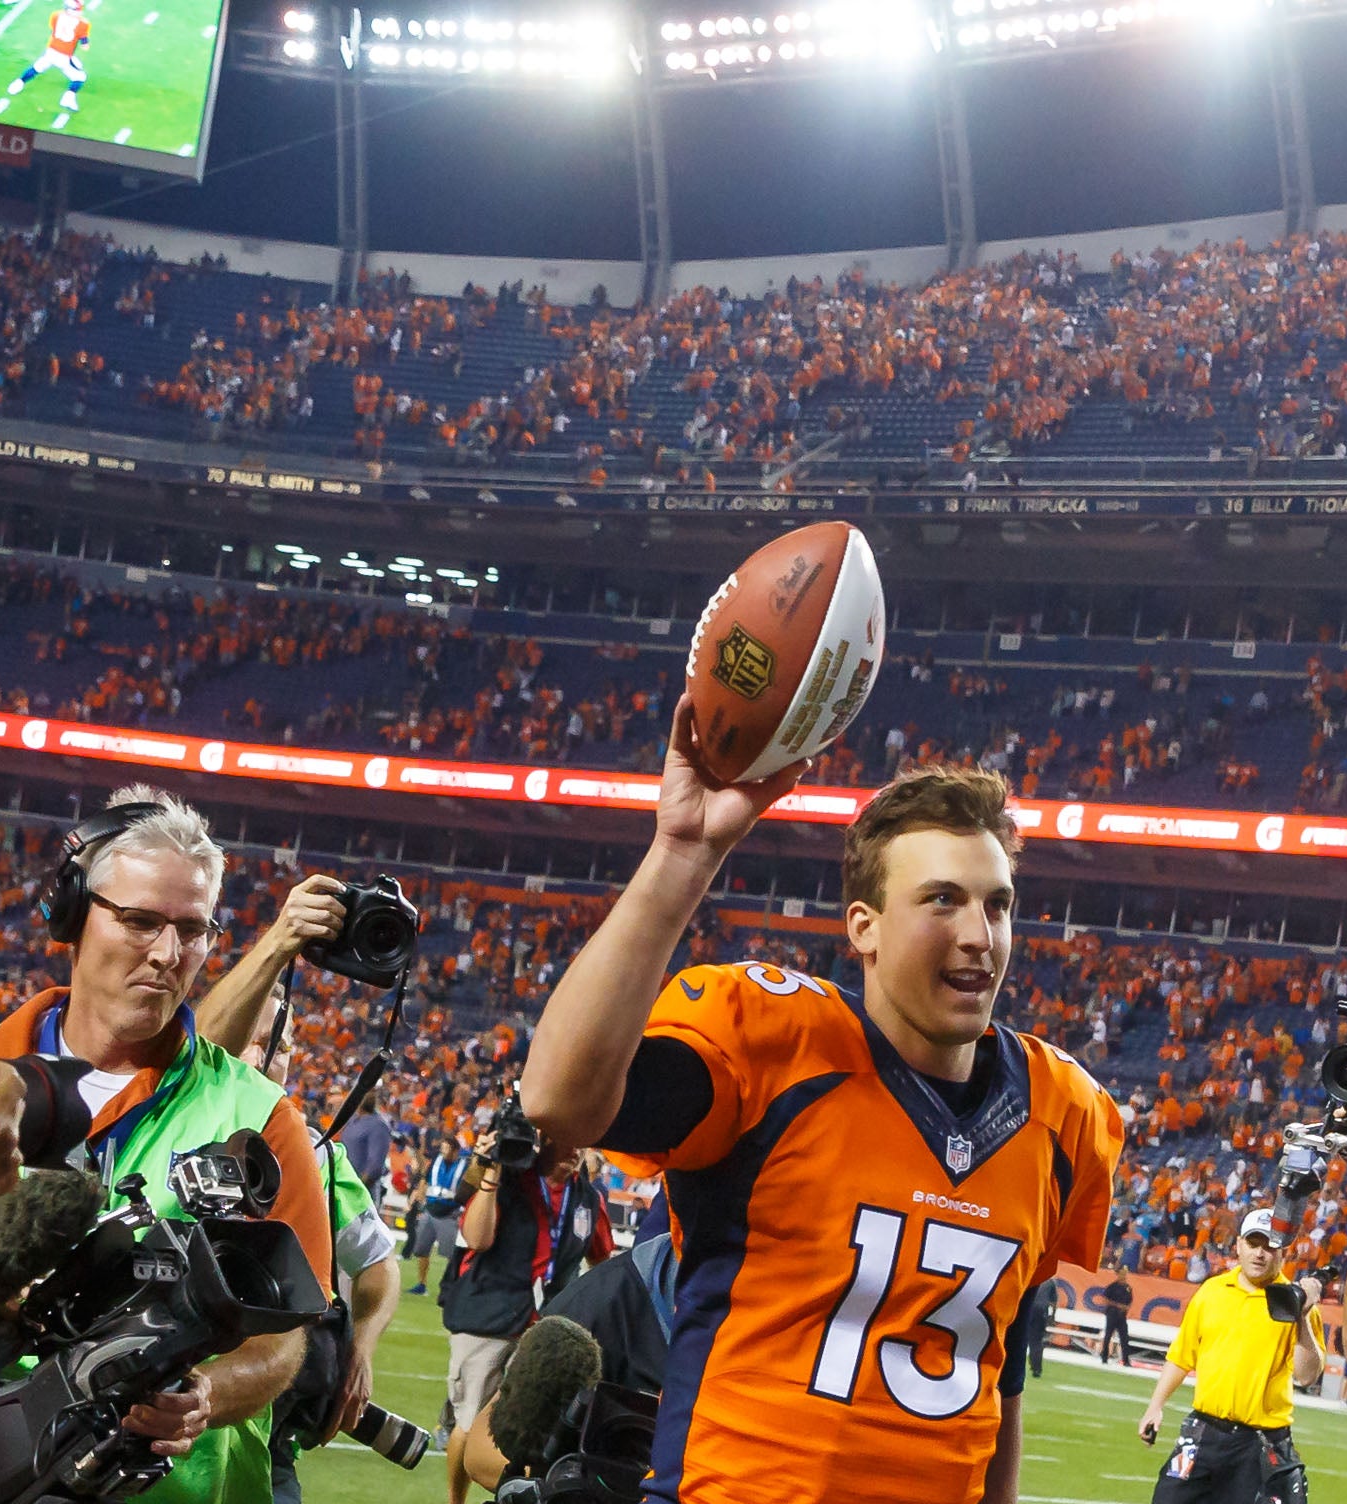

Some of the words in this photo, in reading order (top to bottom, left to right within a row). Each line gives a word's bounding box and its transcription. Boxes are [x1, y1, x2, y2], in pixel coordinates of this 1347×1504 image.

[1251, 498, 1292, 514] BILLY
[733, 645, 769, 694] NFL
[21, 720, 48, 750] G
[199, 741, 225, 772] G
[364, 757, 389, 788] G
[524, 769, 549, 800] G
[1056, 803, 1085, 838] G
[1255, 816, 1285, 851] G
[912, 1190, 990, 1219] BRONCOS
[807, 1203, 1022, 1420] 13
